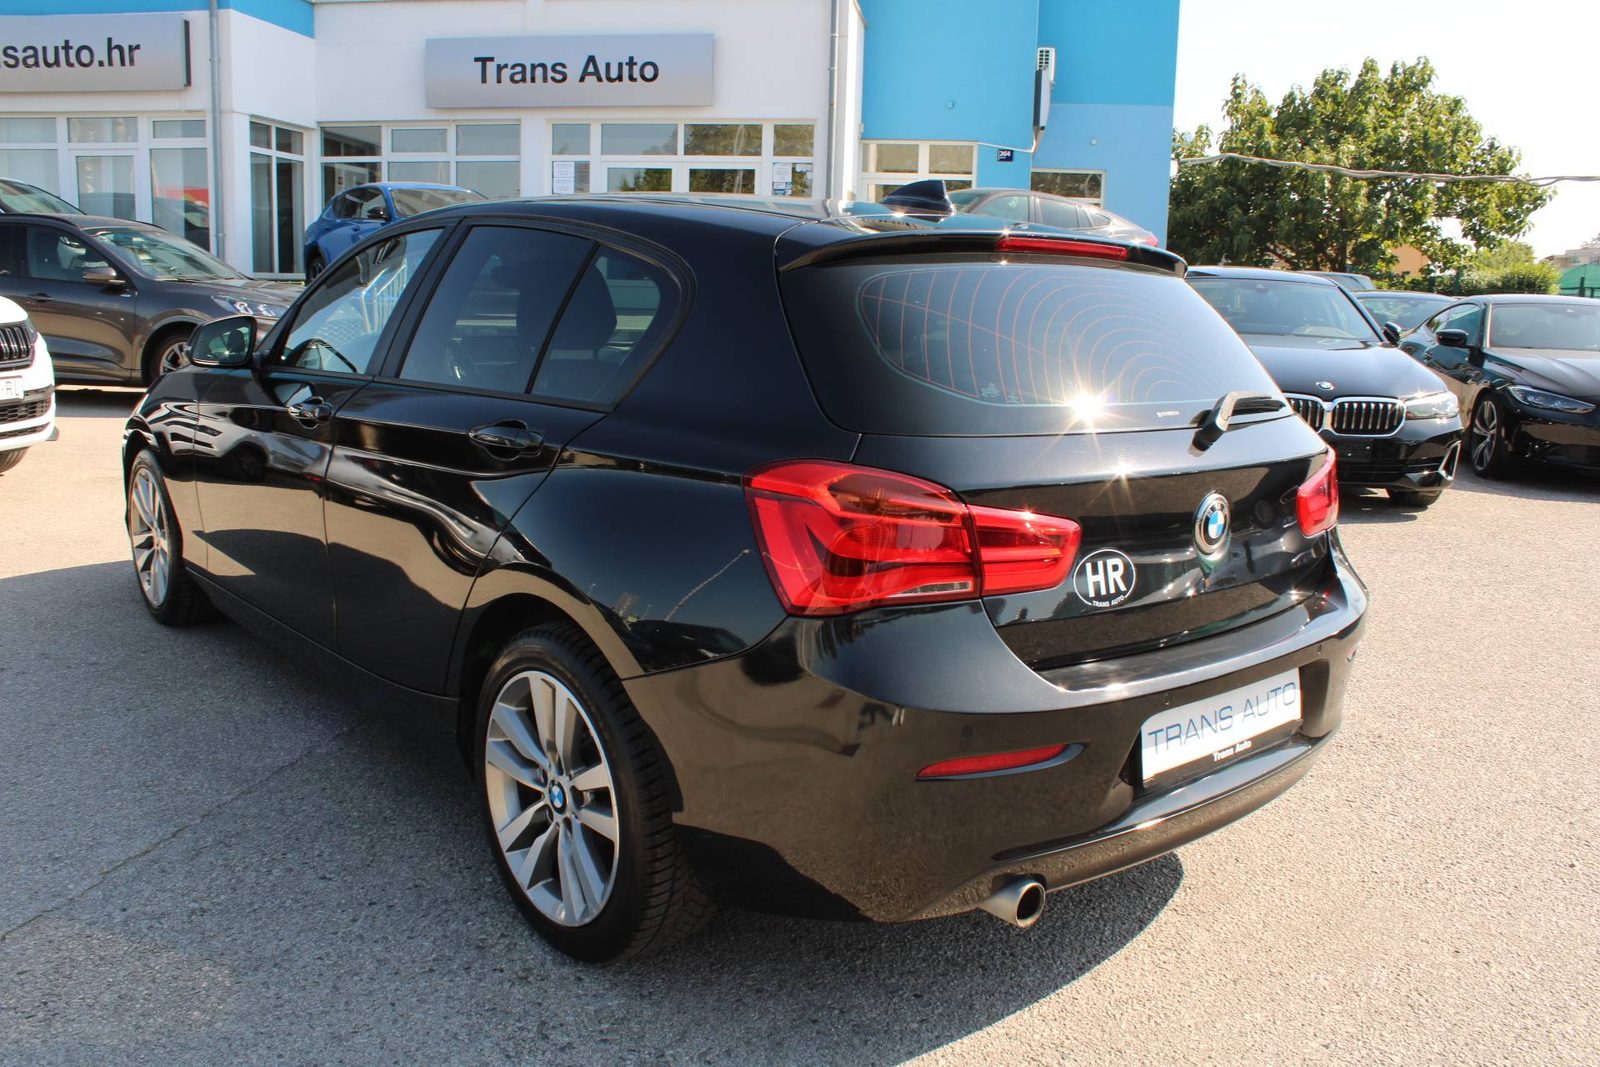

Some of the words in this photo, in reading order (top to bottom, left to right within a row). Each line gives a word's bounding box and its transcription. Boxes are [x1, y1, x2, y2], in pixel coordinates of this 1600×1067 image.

[0, 37, 141, 69] sauto.hr
[473, 56, 568, 84] Trans
[578, 55, 660, 83] Auto
[1086, 558, 1127, 597] HR
[1111, 595, 1124, 605] AUTO
[1148, 706, 1233, 754] TRANS
[1243, 682, 1295, 721] AUTO
[1212, 747, 1234, 762] Trans
[1234, 740, 1252, 753] Auto
